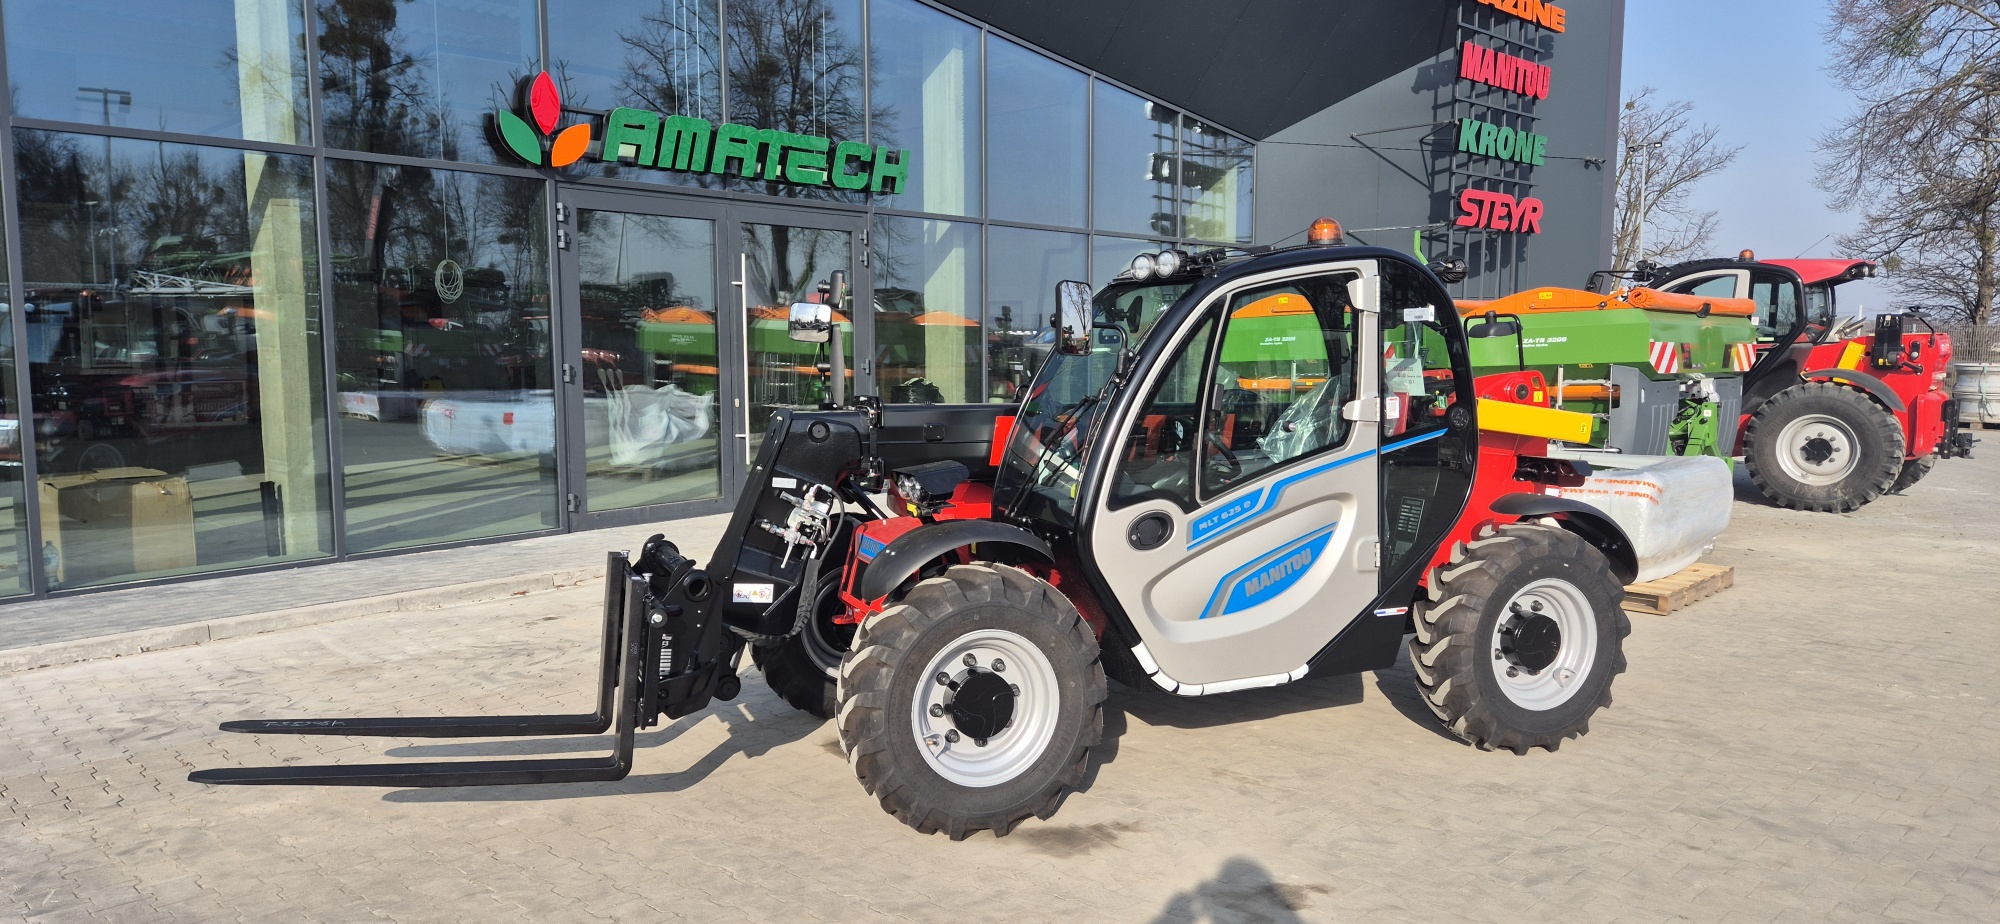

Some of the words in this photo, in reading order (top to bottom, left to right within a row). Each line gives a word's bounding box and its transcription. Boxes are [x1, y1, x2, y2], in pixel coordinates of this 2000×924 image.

[1461, 41, 1551, 100] MANITOU
[602, 107, 911, 195] AMATECH
[1459, 118, 1548, 166] KRONE
[1456, 188, 1544, 234] STEYR
[1199, 515, 1219, 530] MLT
[1221, 504, 1242, 520] 625
[1244, 547, 1312, 598] MANITOU
